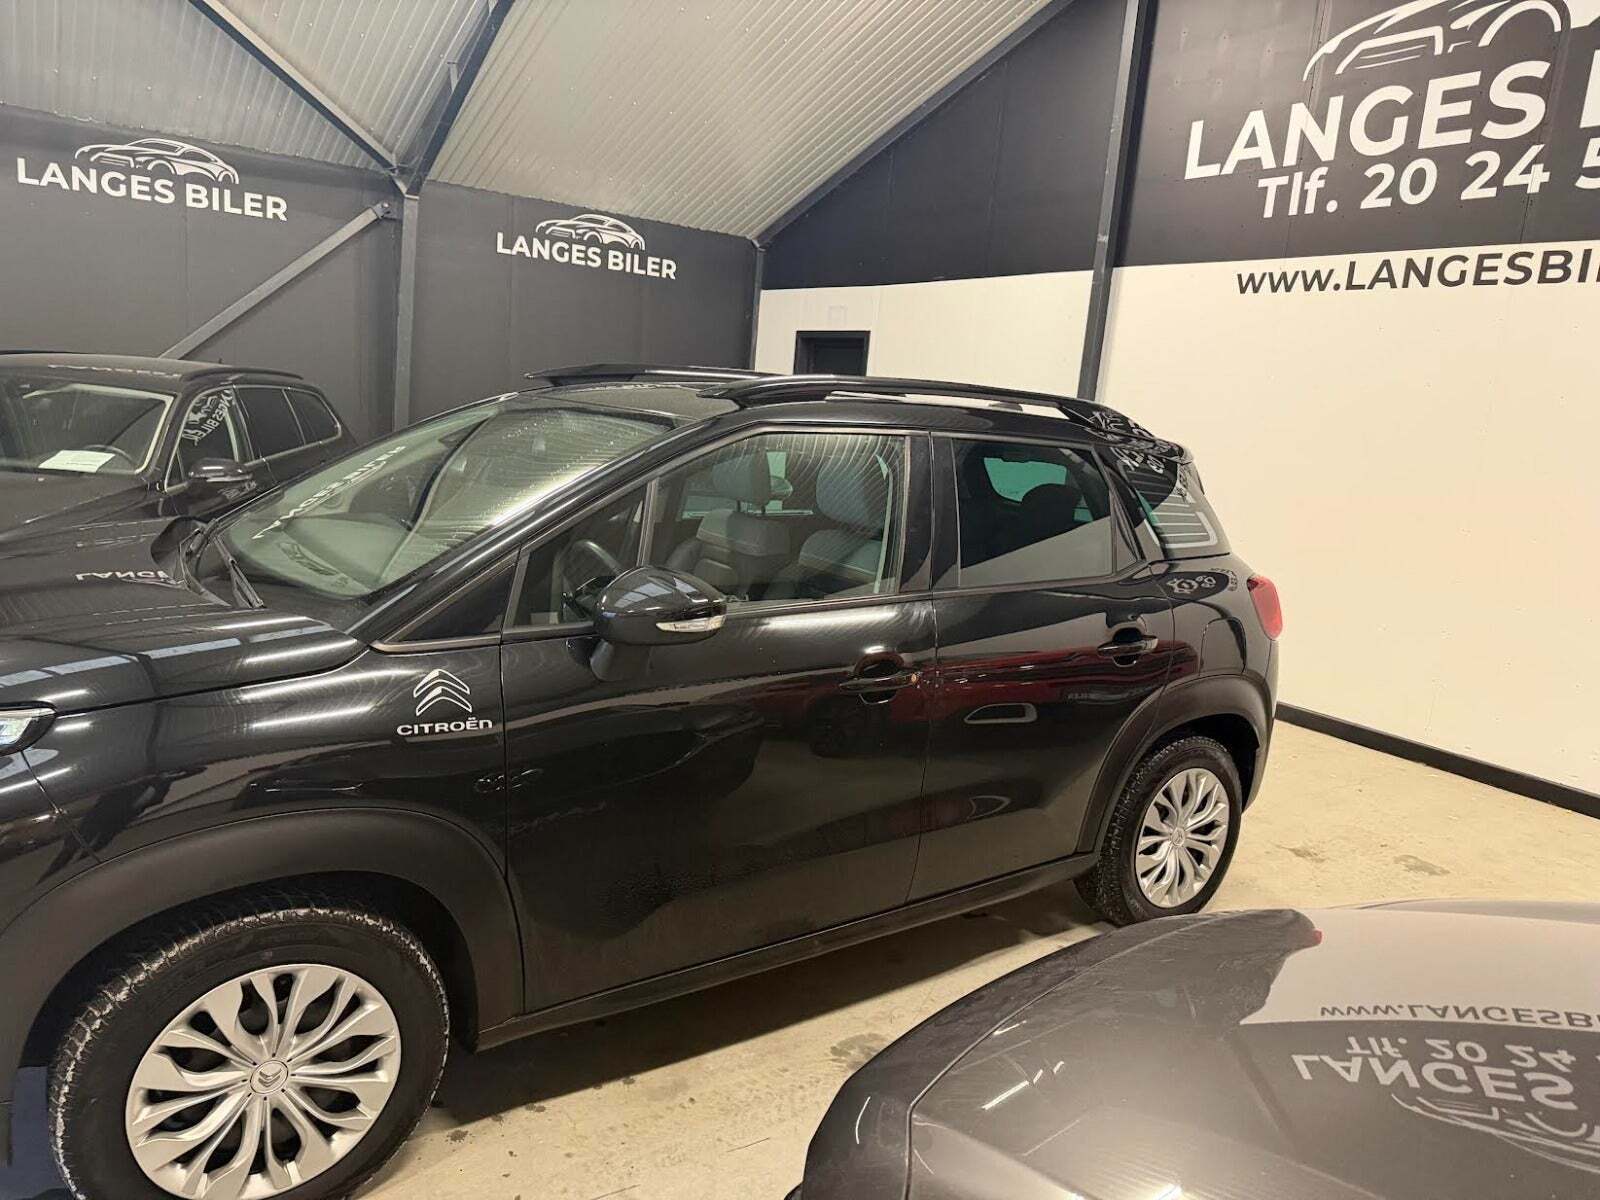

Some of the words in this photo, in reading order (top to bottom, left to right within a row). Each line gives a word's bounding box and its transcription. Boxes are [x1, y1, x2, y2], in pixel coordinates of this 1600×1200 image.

[1184, 60, 1551, 180] LANGES
[16, 157, 176, 204] LANGES
[185, 183, 288, 222] BILER
[1257, 166, 1338, 219] Tlf.
[1360, 157, 1438, 209] 20
[1460, 143, 1551, 200] 24
[496, 231, 602, 268] LANGES
[607, 249, 677, 280] BILER
[1236, 248, 1600, 294] www.LANGESBI
